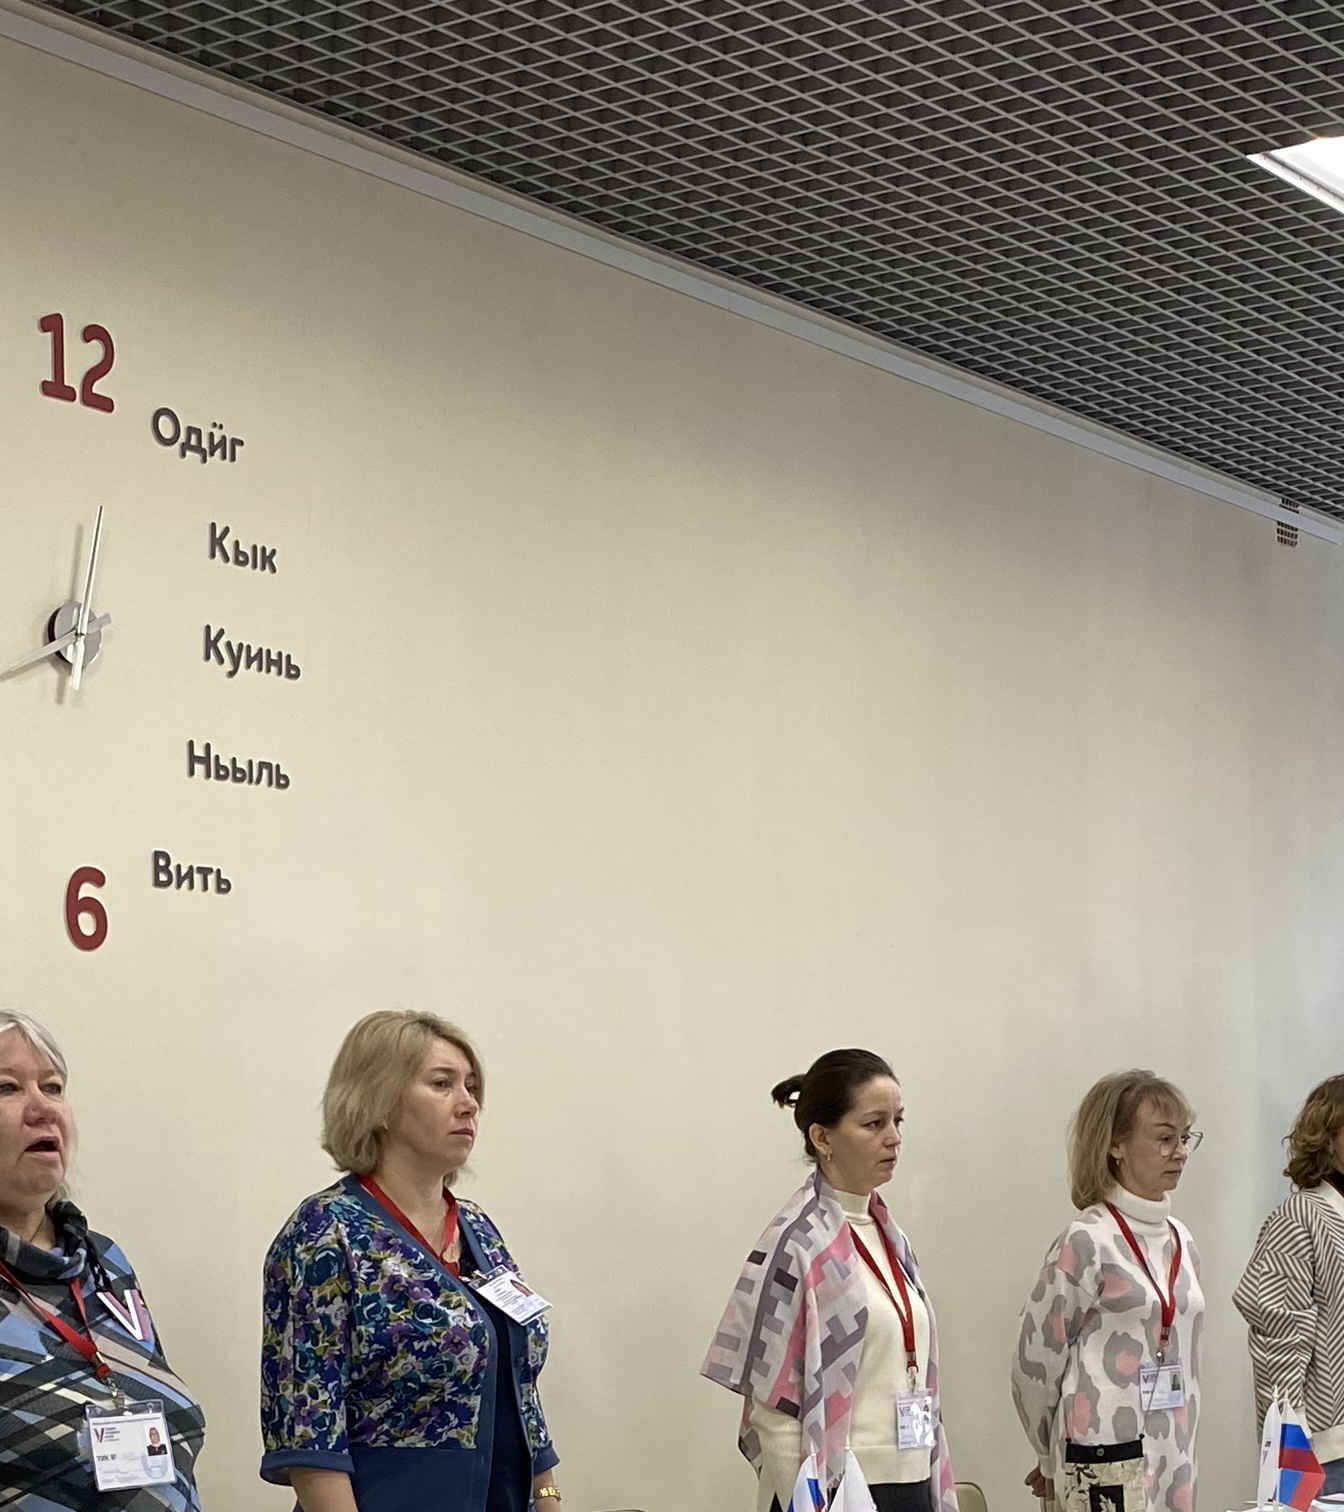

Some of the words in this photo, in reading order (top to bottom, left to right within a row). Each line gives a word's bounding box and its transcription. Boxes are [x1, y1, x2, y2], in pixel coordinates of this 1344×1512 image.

[38, 313, 115, 413] 12
[151, 407, 244, 464] Одӥг
[208, 521, 277, 574] Кык
[203, 624, 301, 680] Куинь
[186, 739, 290, 790] Ньыль
[152, 850, 232, 894] Вить
[66, 865, 108, 951] 6
